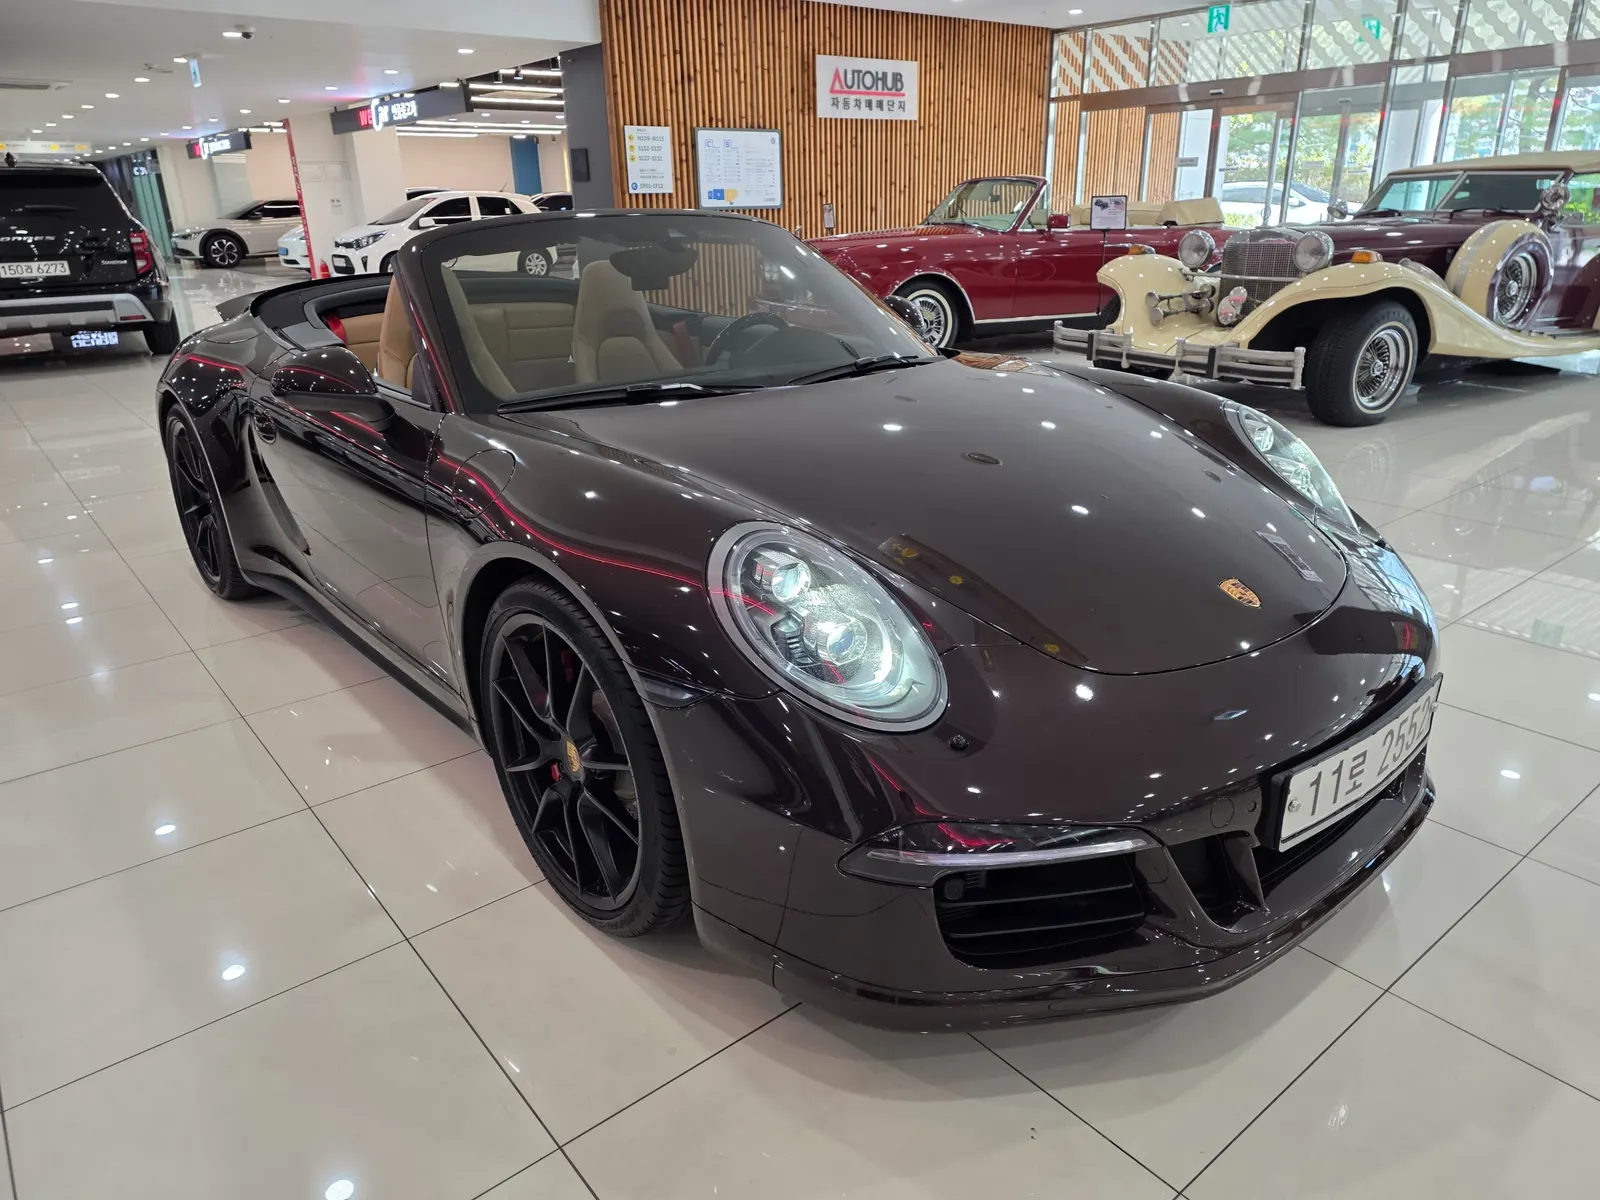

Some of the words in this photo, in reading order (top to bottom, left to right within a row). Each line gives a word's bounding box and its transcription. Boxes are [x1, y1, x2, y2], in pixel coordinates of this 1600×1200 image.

[829, 67, 905, 96] AUTOHUB
[831, 97, 906, 113] 자동차매매단지
[36, 262, 67, 274] 6273
[1309, 750, 1368, 817] 11로
[1377, 696, 1431, 776] 2552
